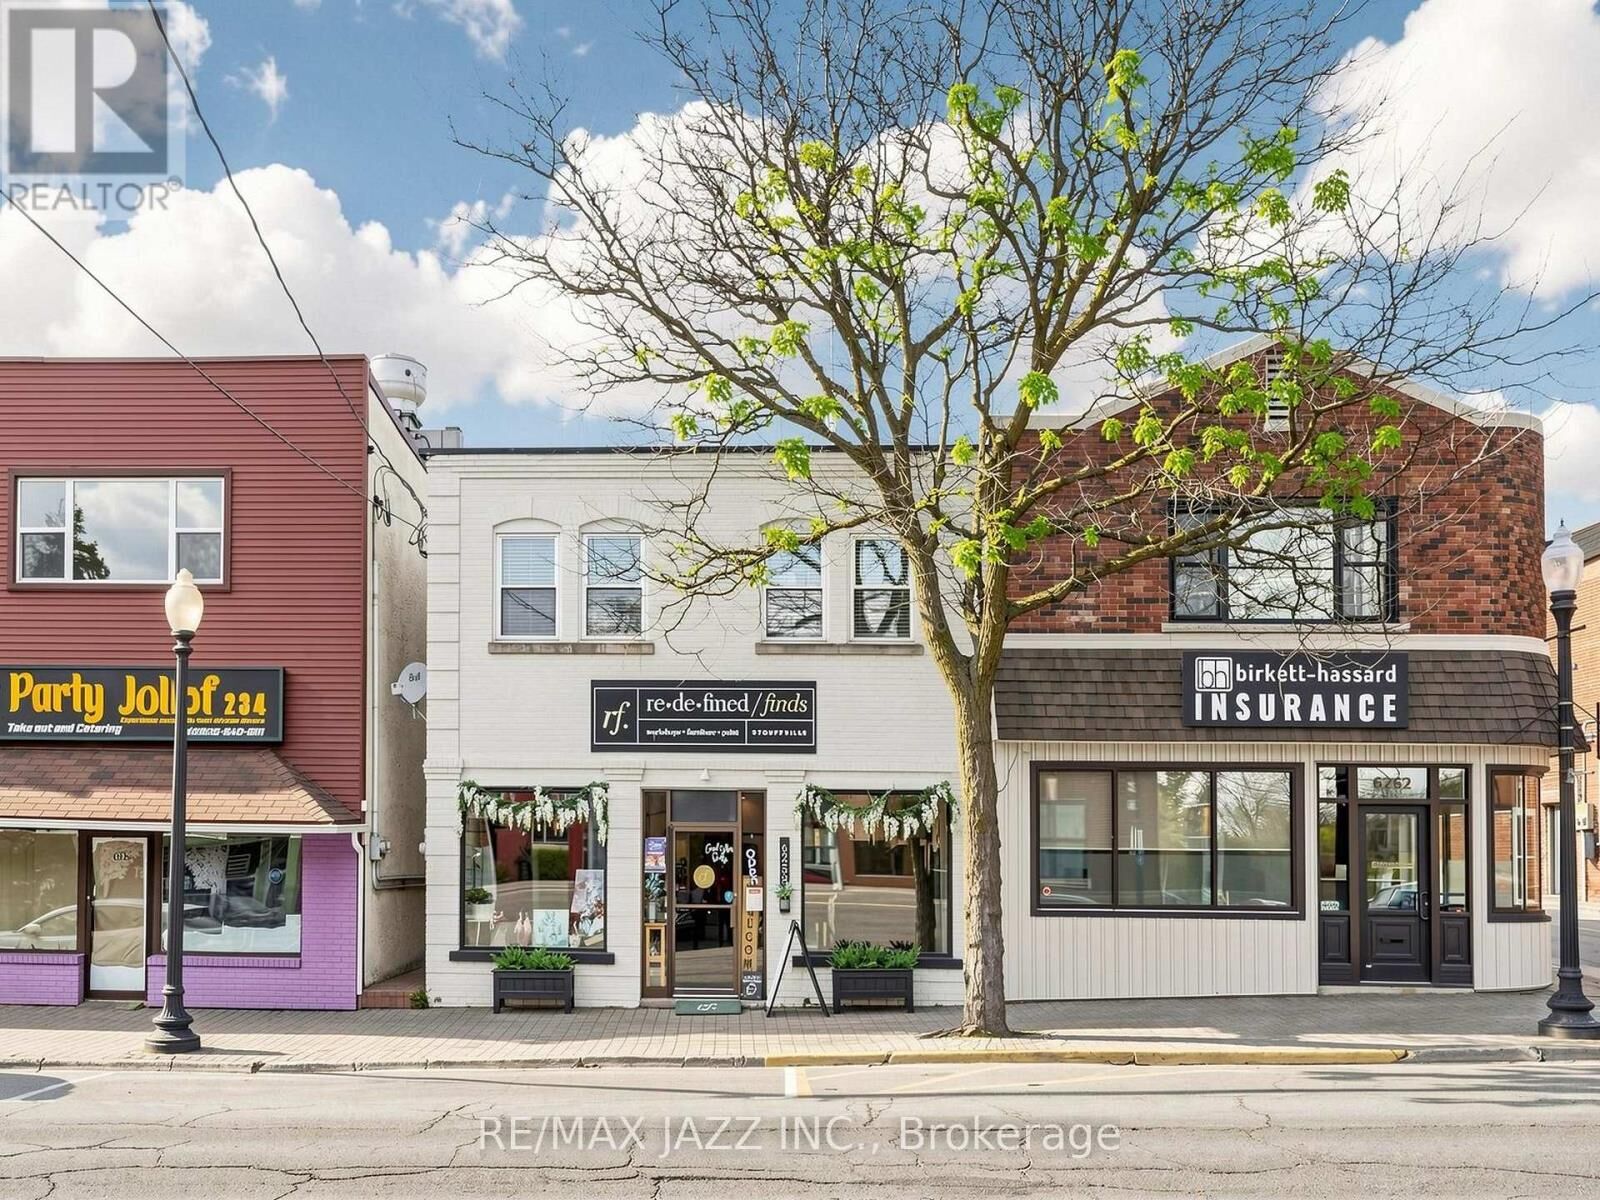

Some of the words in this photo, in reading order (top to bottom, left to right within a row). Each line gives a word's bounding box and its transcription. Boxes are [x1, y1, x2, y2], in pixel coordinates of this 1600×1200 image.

[1236, 661, 1397, 683] birkett-hassard
[8, 671, 104, 724] Party
[224, 692, 267, 716] 234
[1195, 692, 1397, 722] INSURANCE
[8, 722, 33, 733] Take
[34, 723, 54, 733] out
[54, 723, 75, 733] and
[76, 723, 122, 735] Catering
[1373, 776, 1412, 789] 6262
